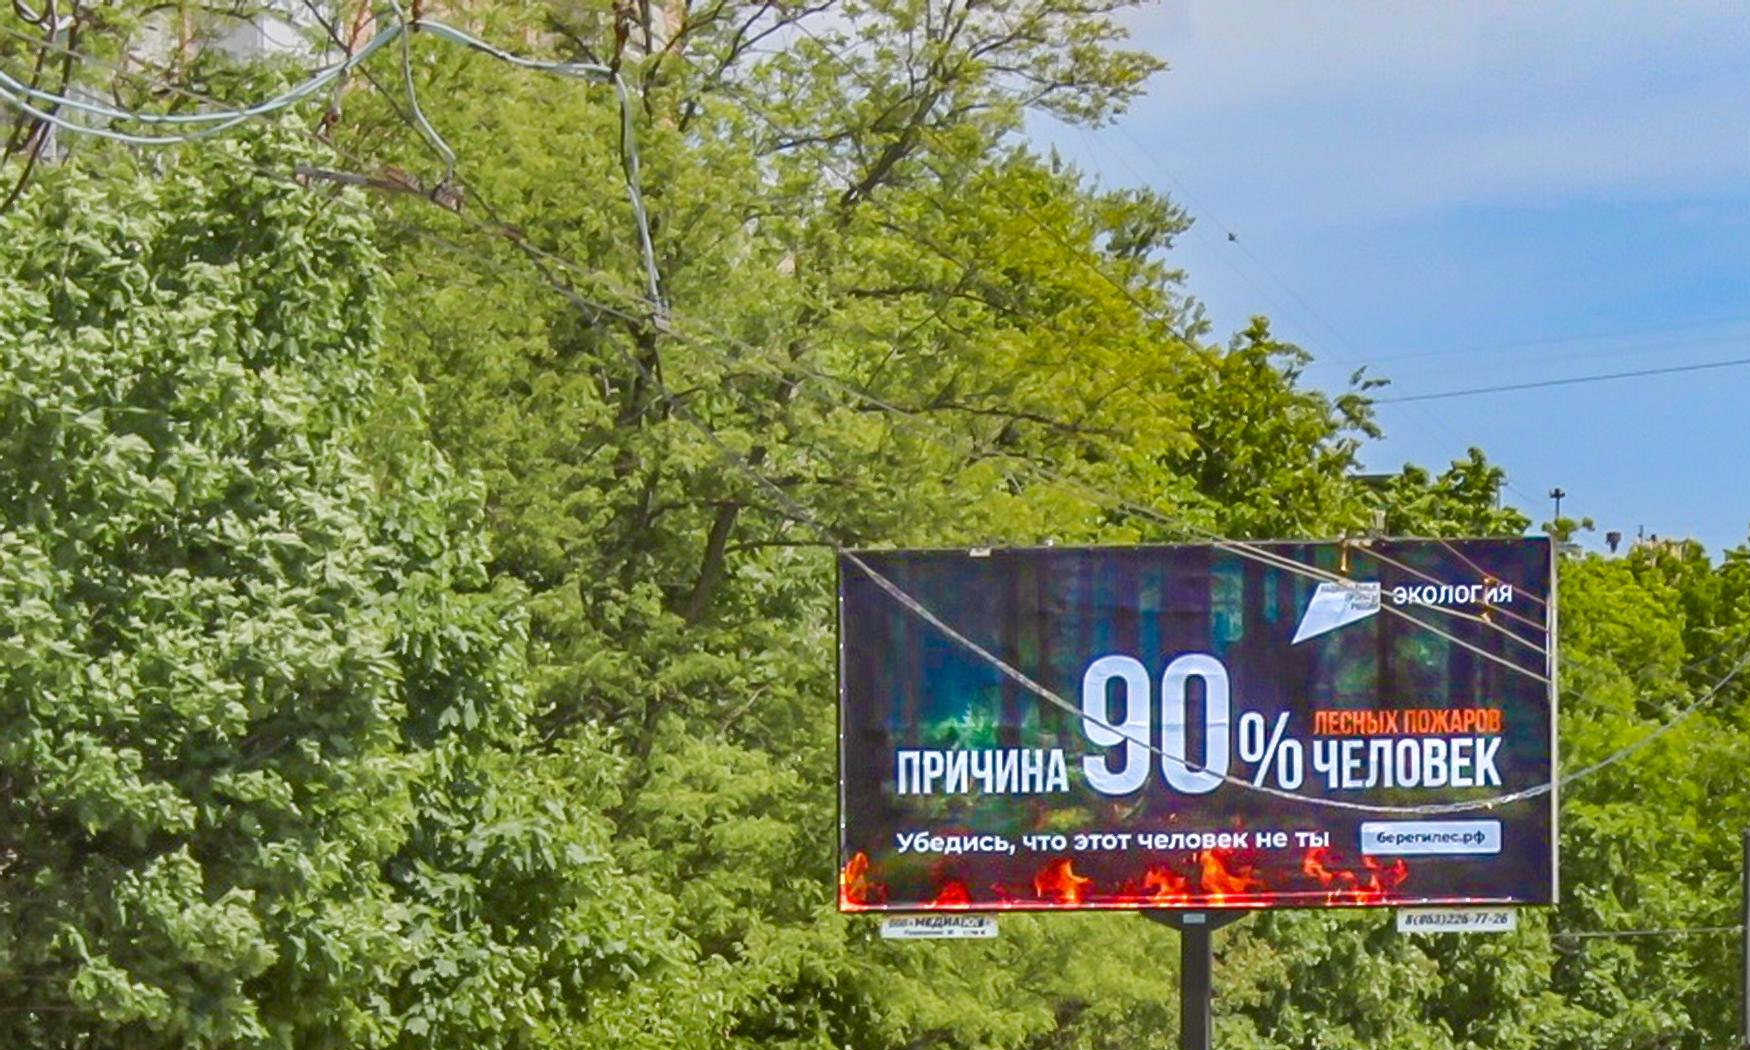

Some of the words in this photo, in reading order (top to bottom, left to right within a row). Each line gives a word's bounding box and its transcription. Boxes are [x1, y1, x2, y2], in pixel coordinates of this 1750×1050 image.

[1393, 584, 1513, 605] ЭКОЛОГИЯ
[1313, 710, 1398, 735] ЛЕСНЫХ
[1404, 708, 1502, 734] ПОЖАРОВ
[897, 748, 1069, 796] ПРИЧИНА
[1312, 736, 1503, 790] ЧЕЛОВЕК
[896, 832, 1016, 856] Убедись,
[1022, 836, 1067, 851] что
[1073, 834, 1131, 850] этот
[1137, 832, 1249, 850] человек
[1255, 831, 1288, 849] не
[1294, 830, 1331, 848] ты
[1376, 829, 1486, 846] берегилес.рф
